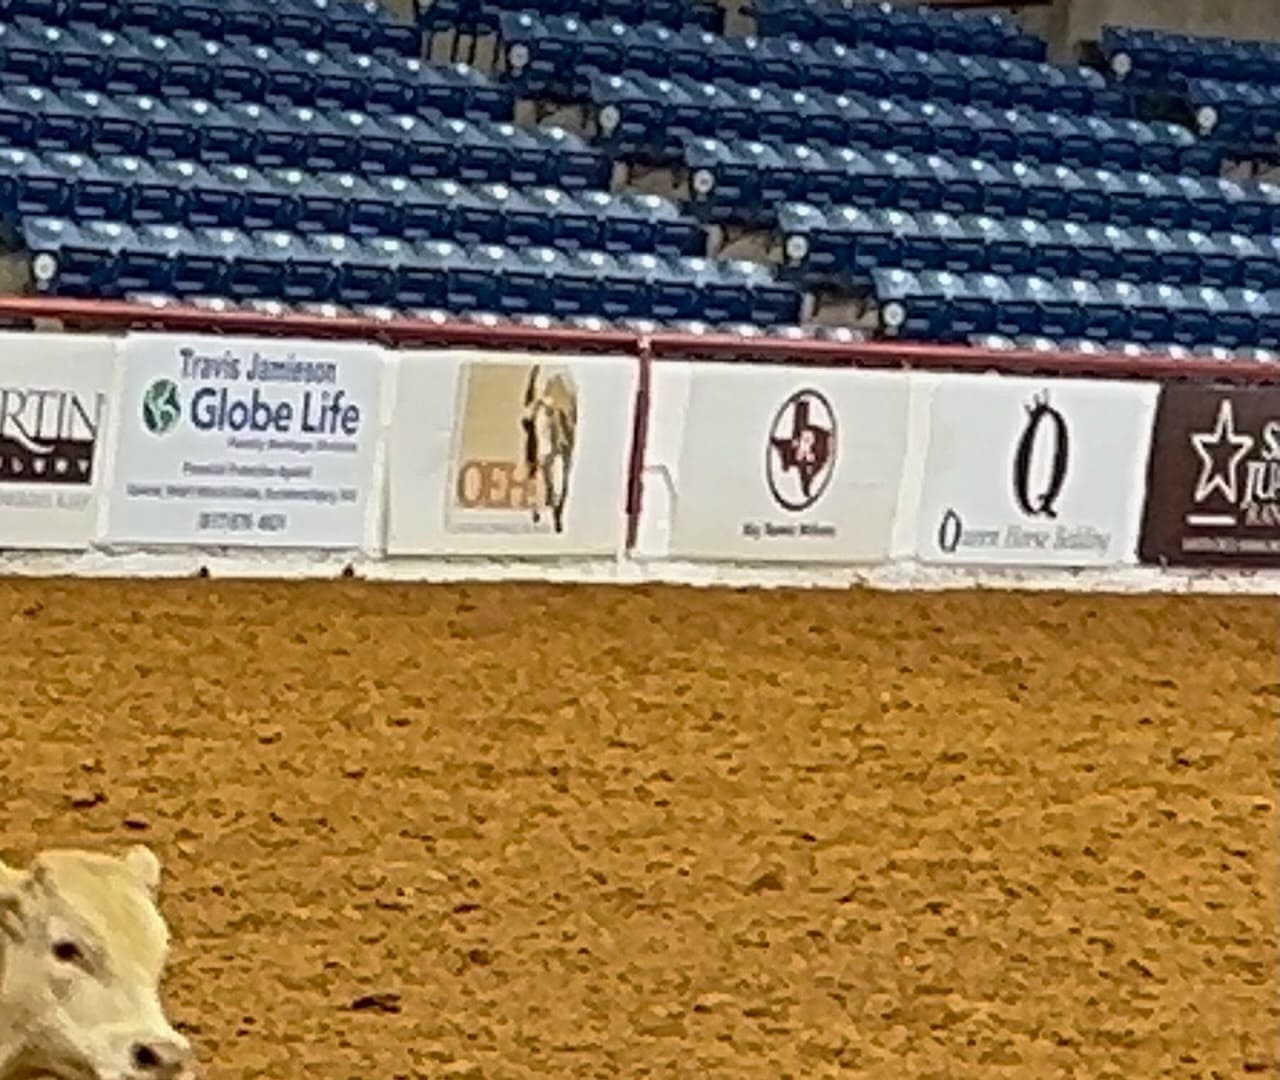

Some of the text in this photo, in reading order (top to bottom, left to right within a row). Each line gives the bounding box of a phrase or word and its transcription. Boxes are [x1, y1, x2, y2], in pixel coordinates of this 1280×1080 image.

[180, 347, 240, 381] Travis
[190, 386, 360, 434] Globe Life
[1013, 402, 1069, 518] Q
